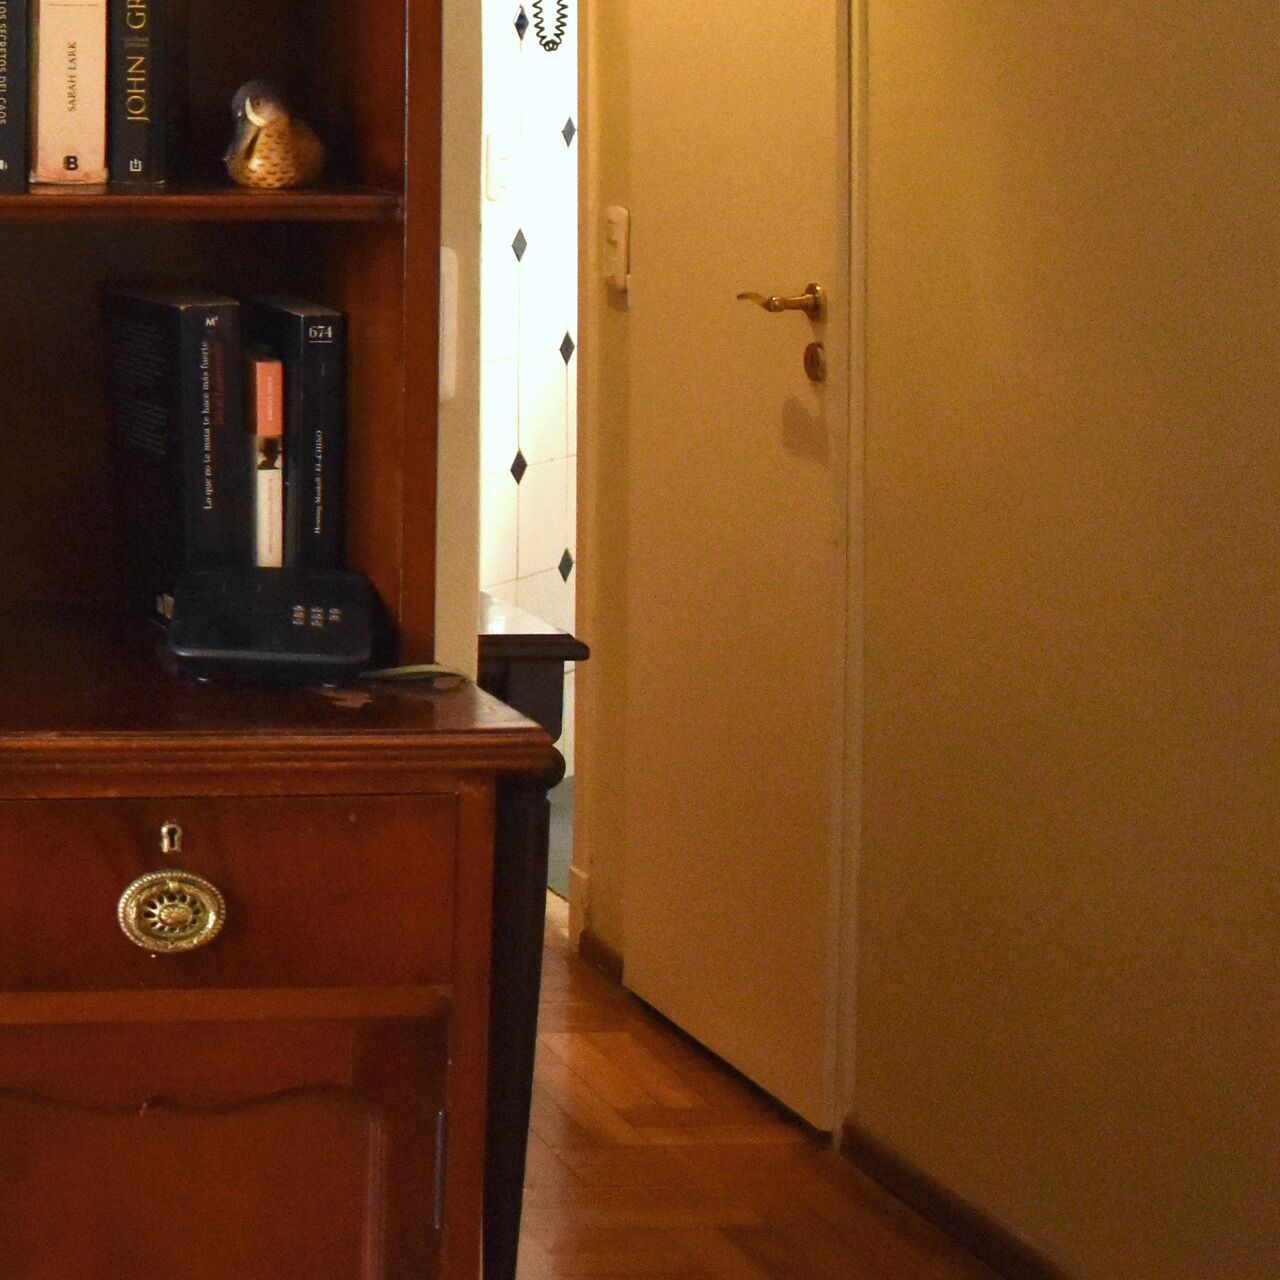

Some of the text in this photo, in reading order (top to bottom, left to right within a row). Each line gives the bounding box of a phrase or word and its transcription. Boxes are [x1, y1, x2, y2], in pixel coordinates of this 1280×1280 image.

[67, 40, 77, 112] SARAH LARK
[126, 55, 150, 122] JOHN
[308, 325, 333, 338] 674
[201, 340, 209, 369] fuerte
[205, 479, 213, 496] que
[204, 497, 213, 509] Lo
